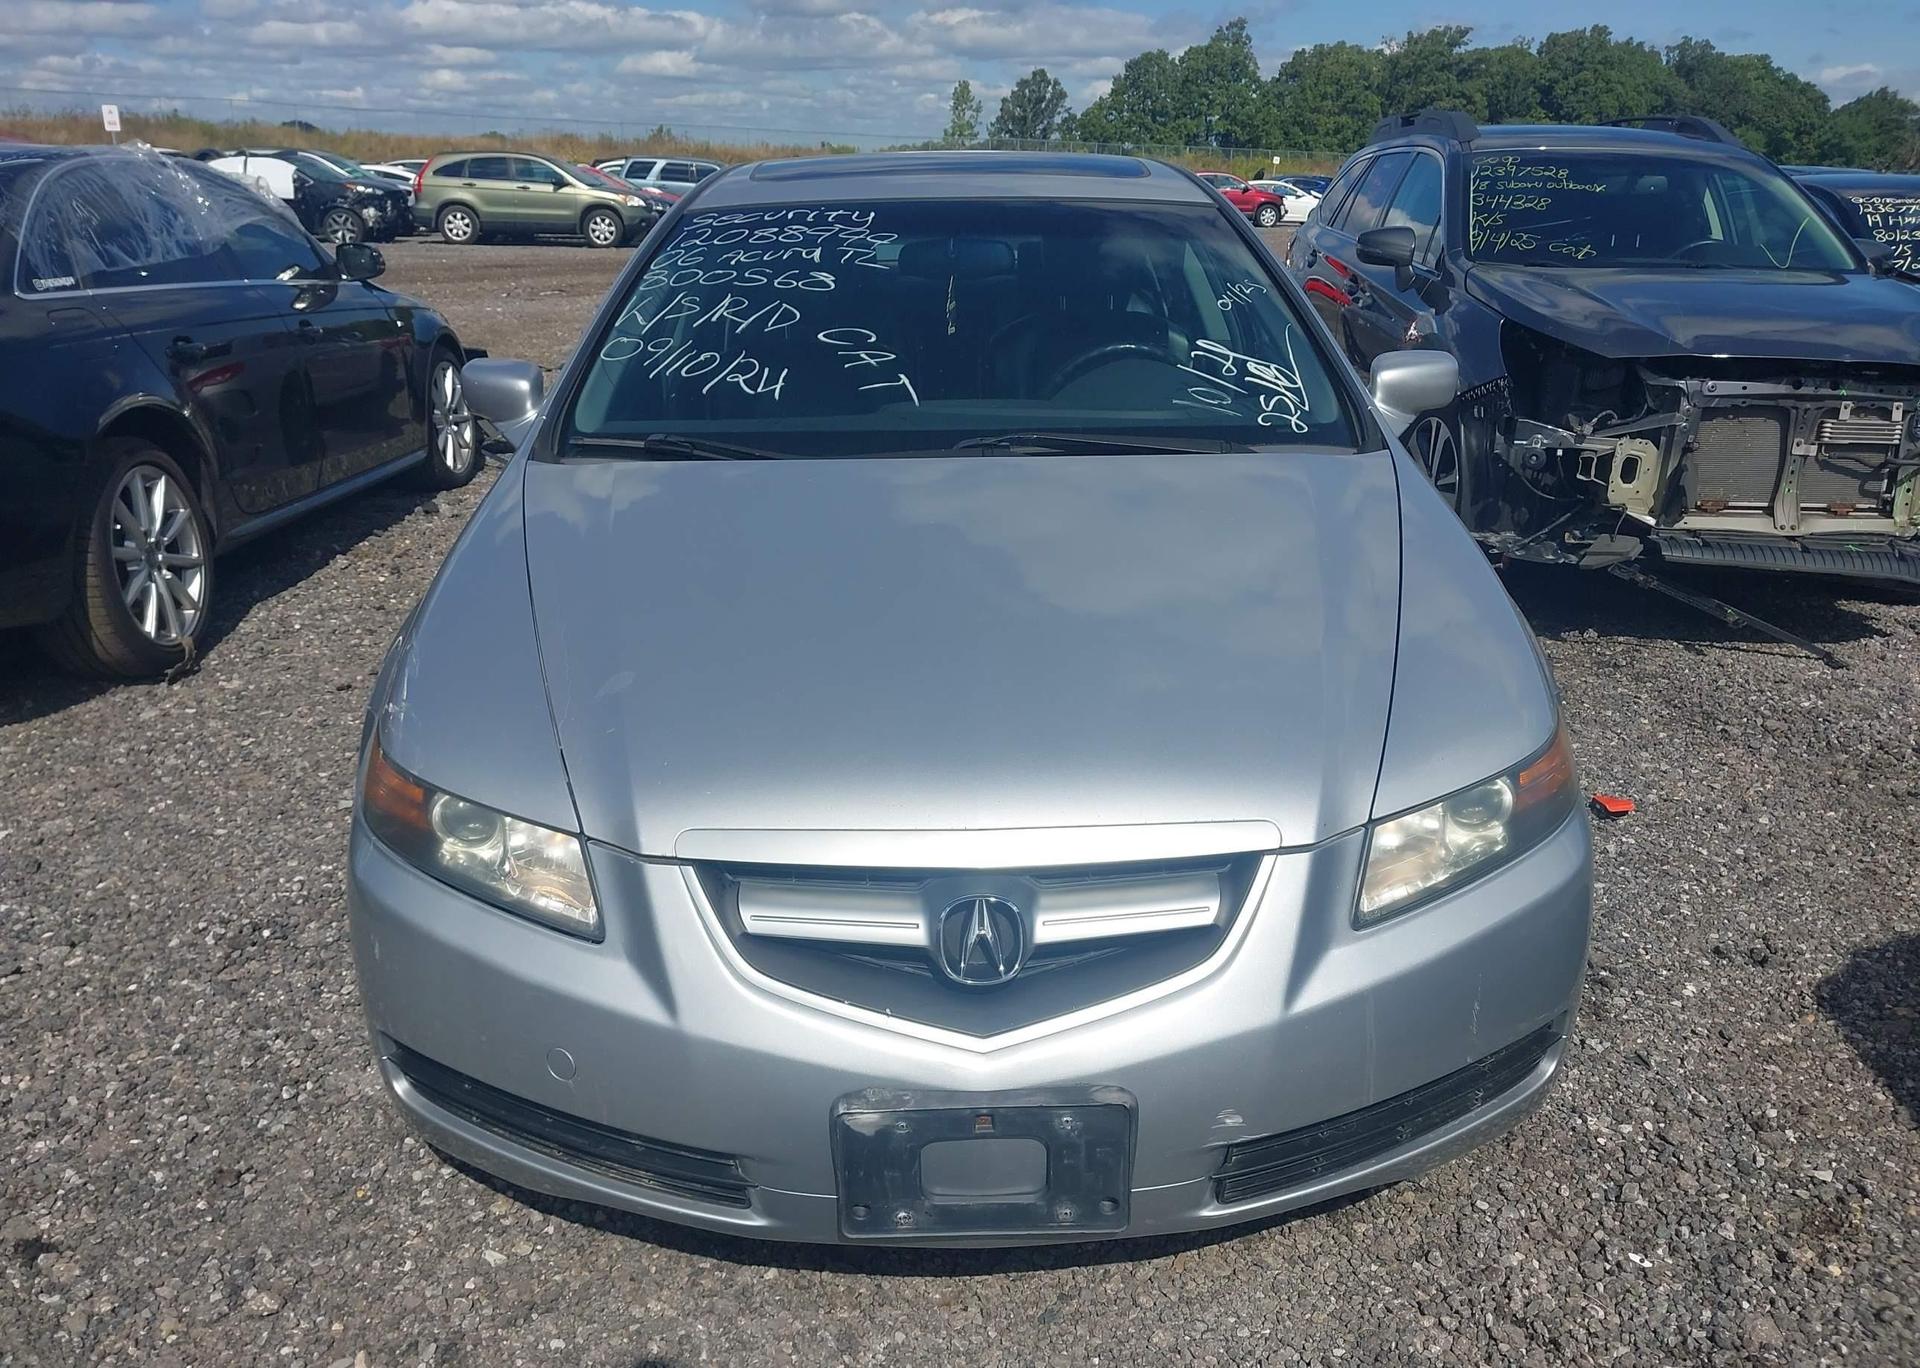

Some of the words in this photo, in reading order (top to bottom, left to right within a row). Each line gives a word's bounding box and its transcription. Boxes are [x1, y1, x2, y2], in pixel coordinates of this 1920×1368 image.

[1866, 213, 1882, 227] 19
[667, 226, 898, 251] 12088999
[650, 247, 704, 270] 06
[840, 247, 890, 271] TL
[639, 267, 836, 291] 800568
